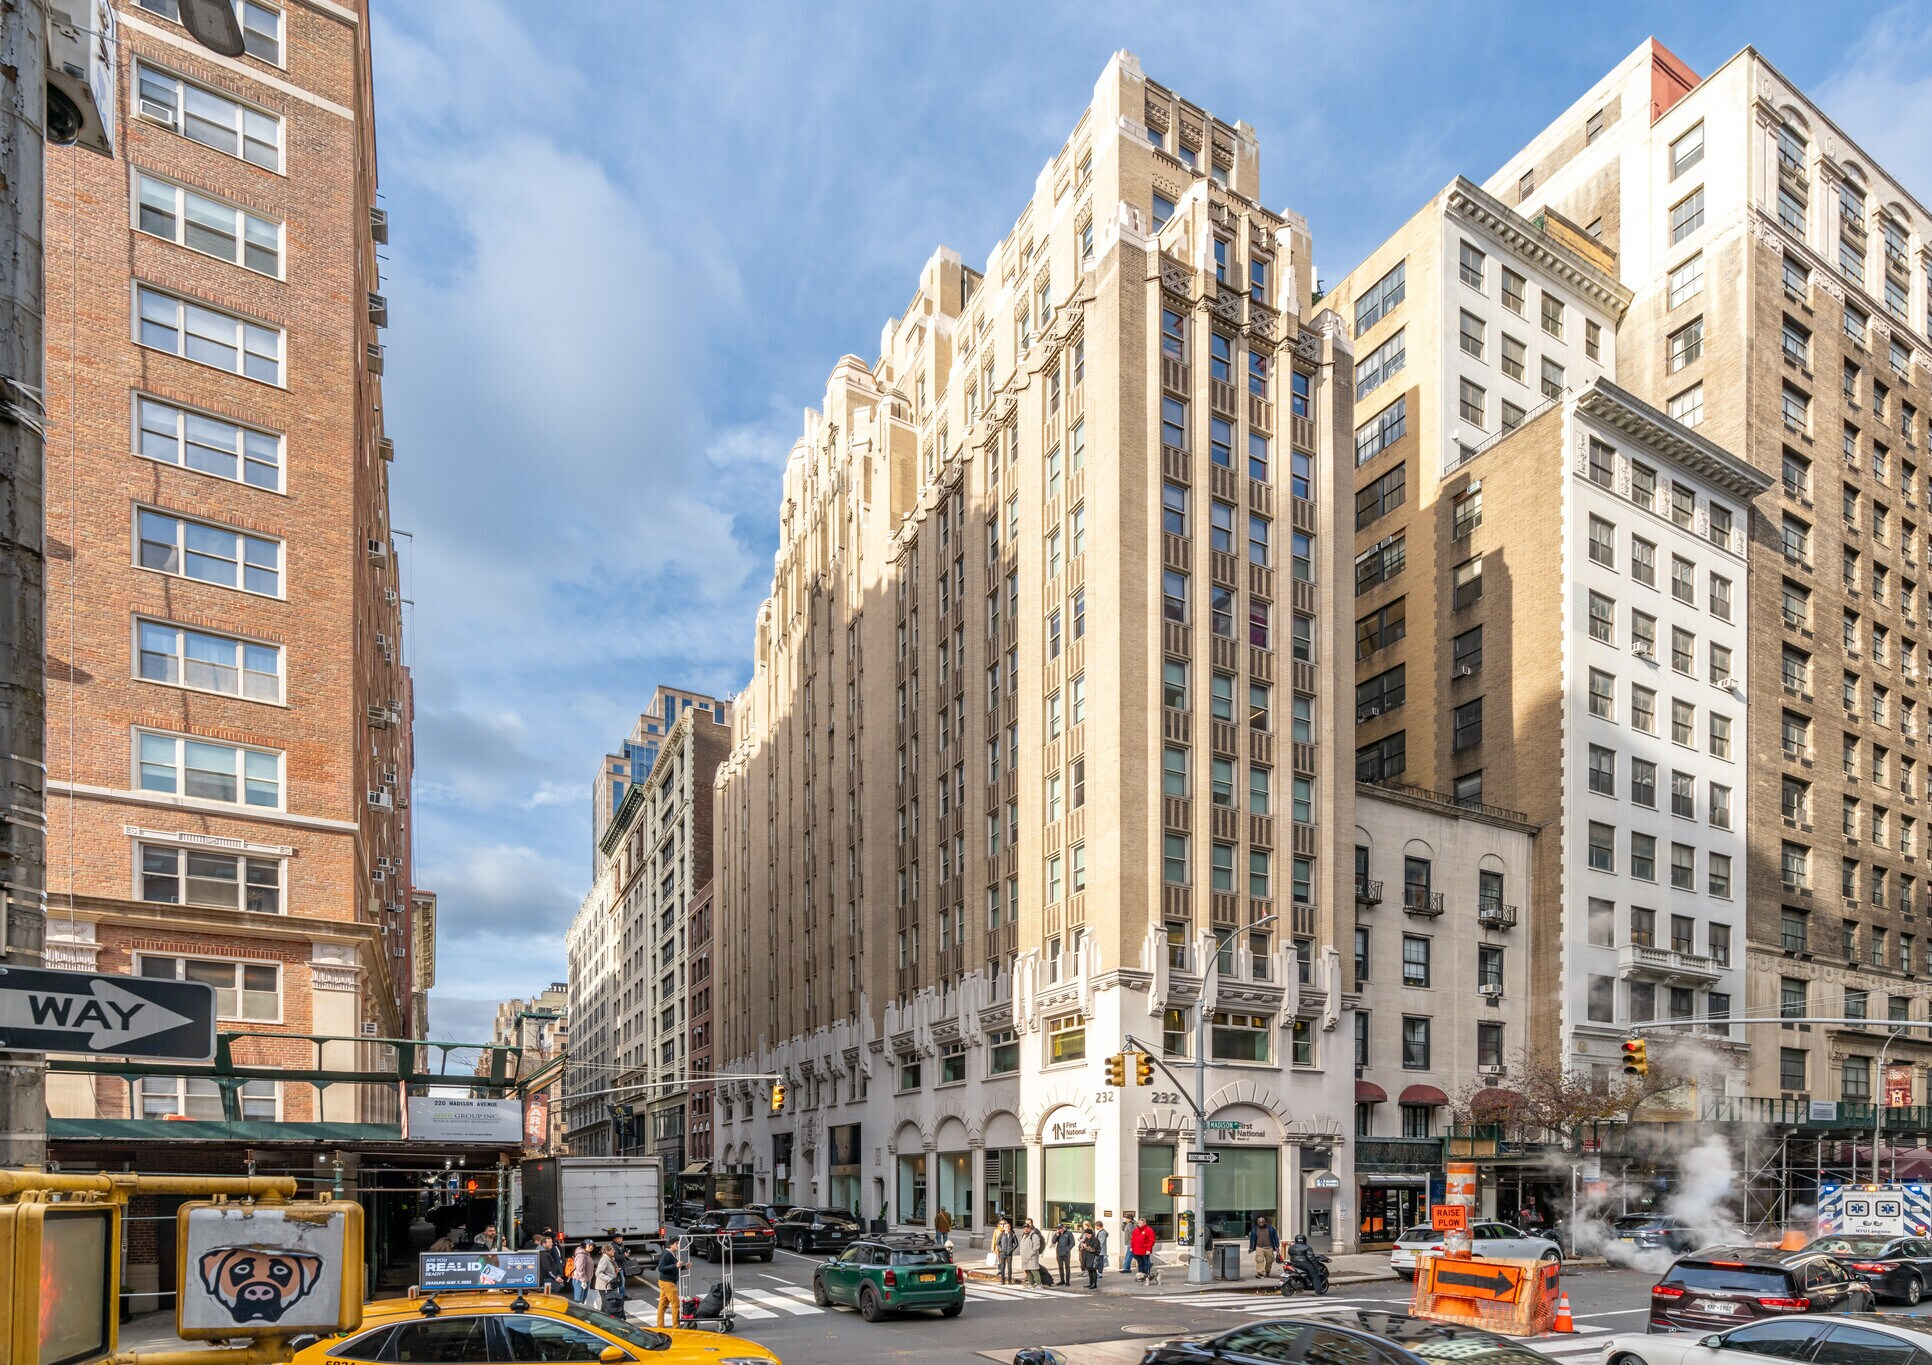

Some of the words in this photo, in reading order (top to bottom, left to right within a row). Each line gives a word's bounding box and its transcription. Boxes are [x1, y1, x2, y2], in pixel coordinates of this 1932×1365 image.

[28, 995, 146, 1031] WAY
[1095, 1091, 1114, 1103] 232
[1151, 1091, 1180, 1104] 232
[1210, 1121, 1233, 1129] MADISON
[1066, 1128, 1086, 1136] National
[1237, 1129, 1265, 1137] National
[1437, 1209, 1460, 1217] RAISE
[1438, 1219, 1460, 1227] PLOW
[425, 1262, 466, 1272] REAL
[467, 1262, 482, 1271] ID
